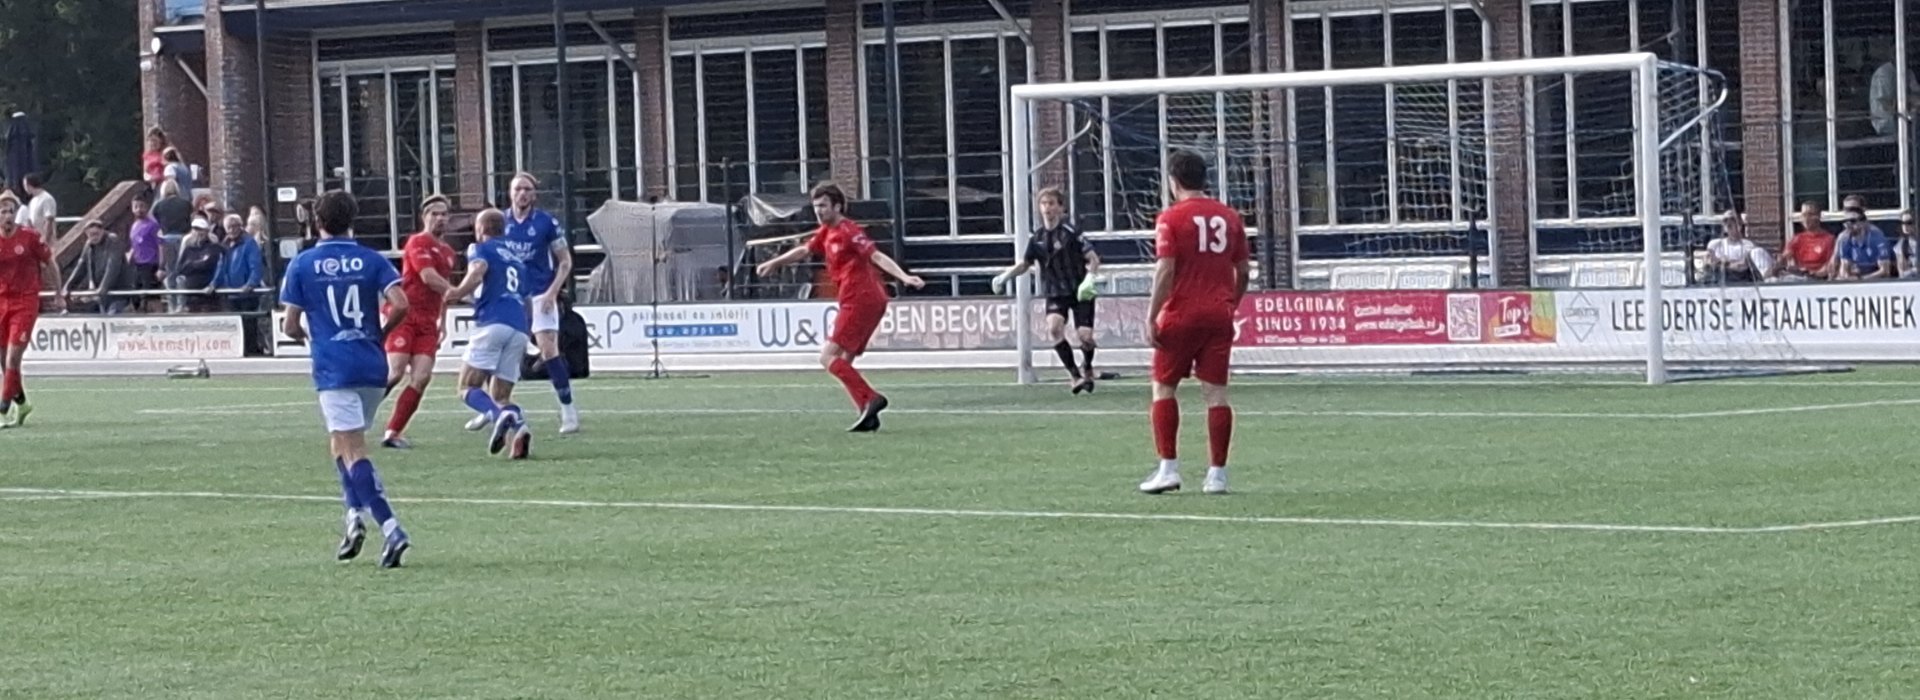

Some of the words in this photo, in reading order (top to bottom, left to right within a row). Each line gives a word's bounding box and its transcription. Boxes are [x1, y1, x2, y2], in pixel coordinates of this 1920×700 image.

[1193, 216, 1227, 252] 13
[506, 266, 519, 292] 8
[327, 284, 364, 328] 14
[1309, 316, 1346, 331] 1934
[1611, 298, 1734, 331] LEEDERTSE
[1741, 295, 1917, 330] METAALTECHNIEK
